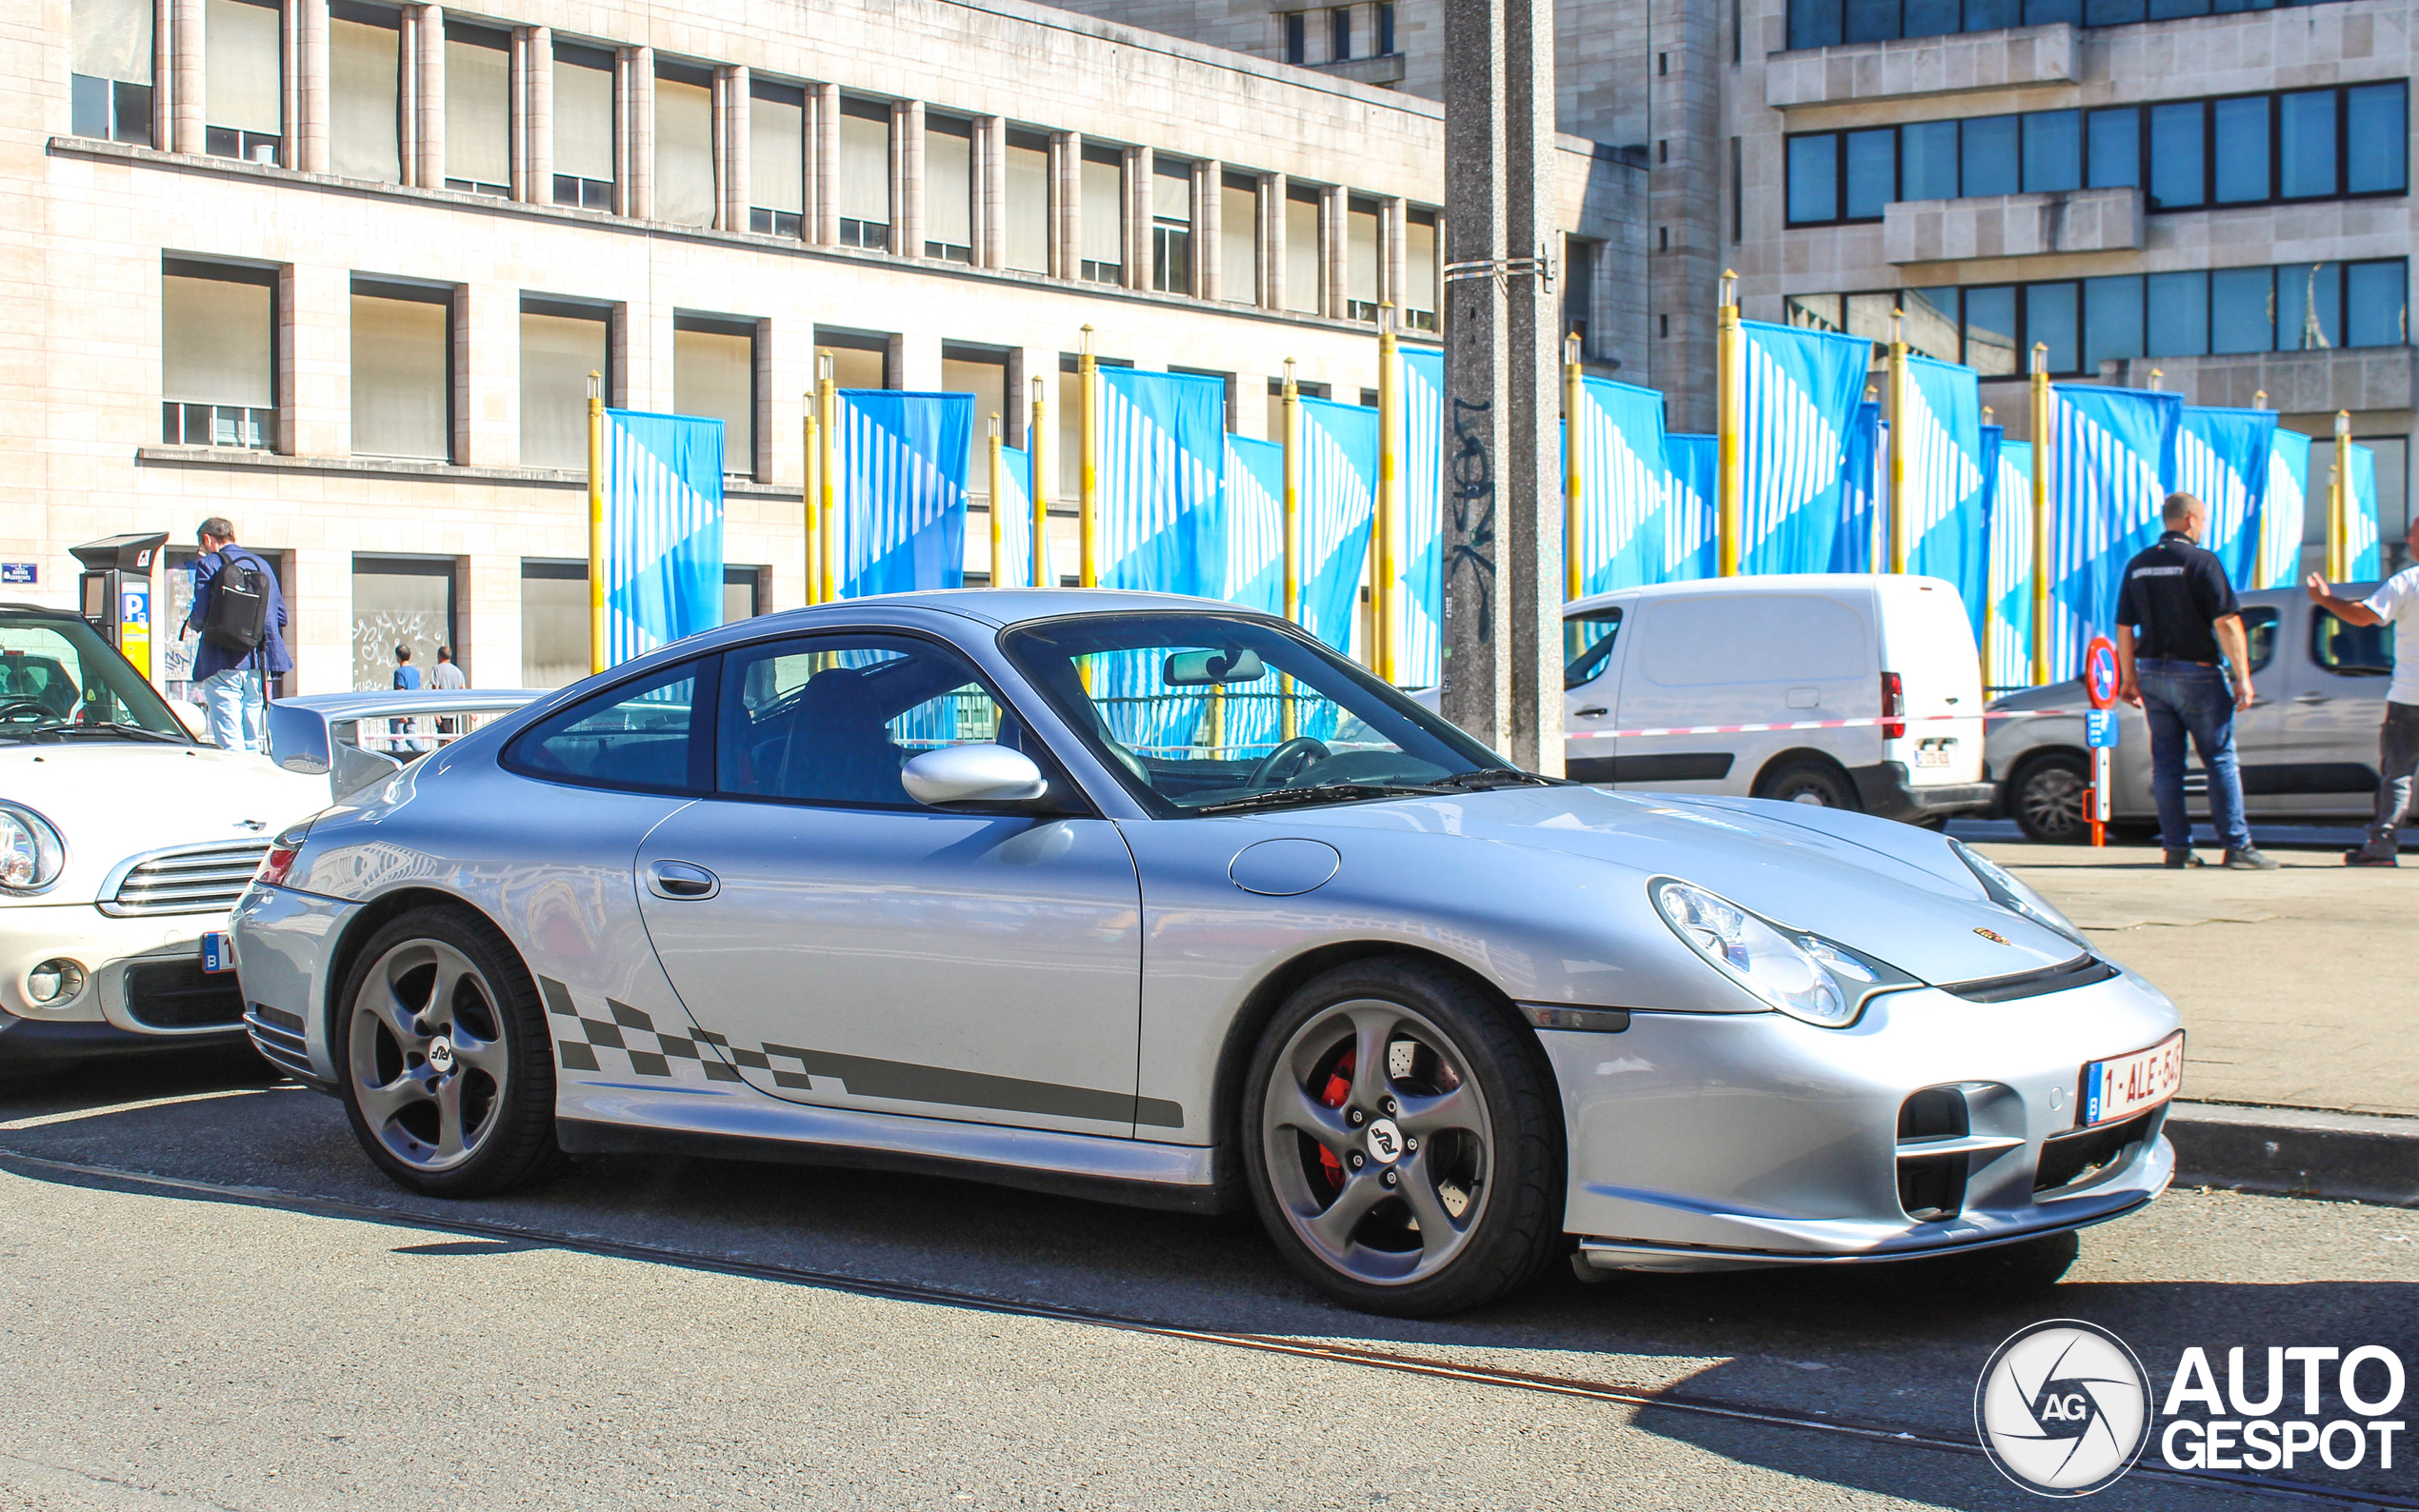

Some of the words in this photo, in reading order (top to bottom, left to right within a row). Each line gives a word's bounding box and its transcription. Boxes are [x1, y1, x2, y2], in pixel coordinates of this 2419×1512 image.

[125, 594, 144, 621] P
[207, 954, 217, 967] B
[2089, 1097, 2099, 1117] B
[1370, 1127, 1399, 1156] RUF
